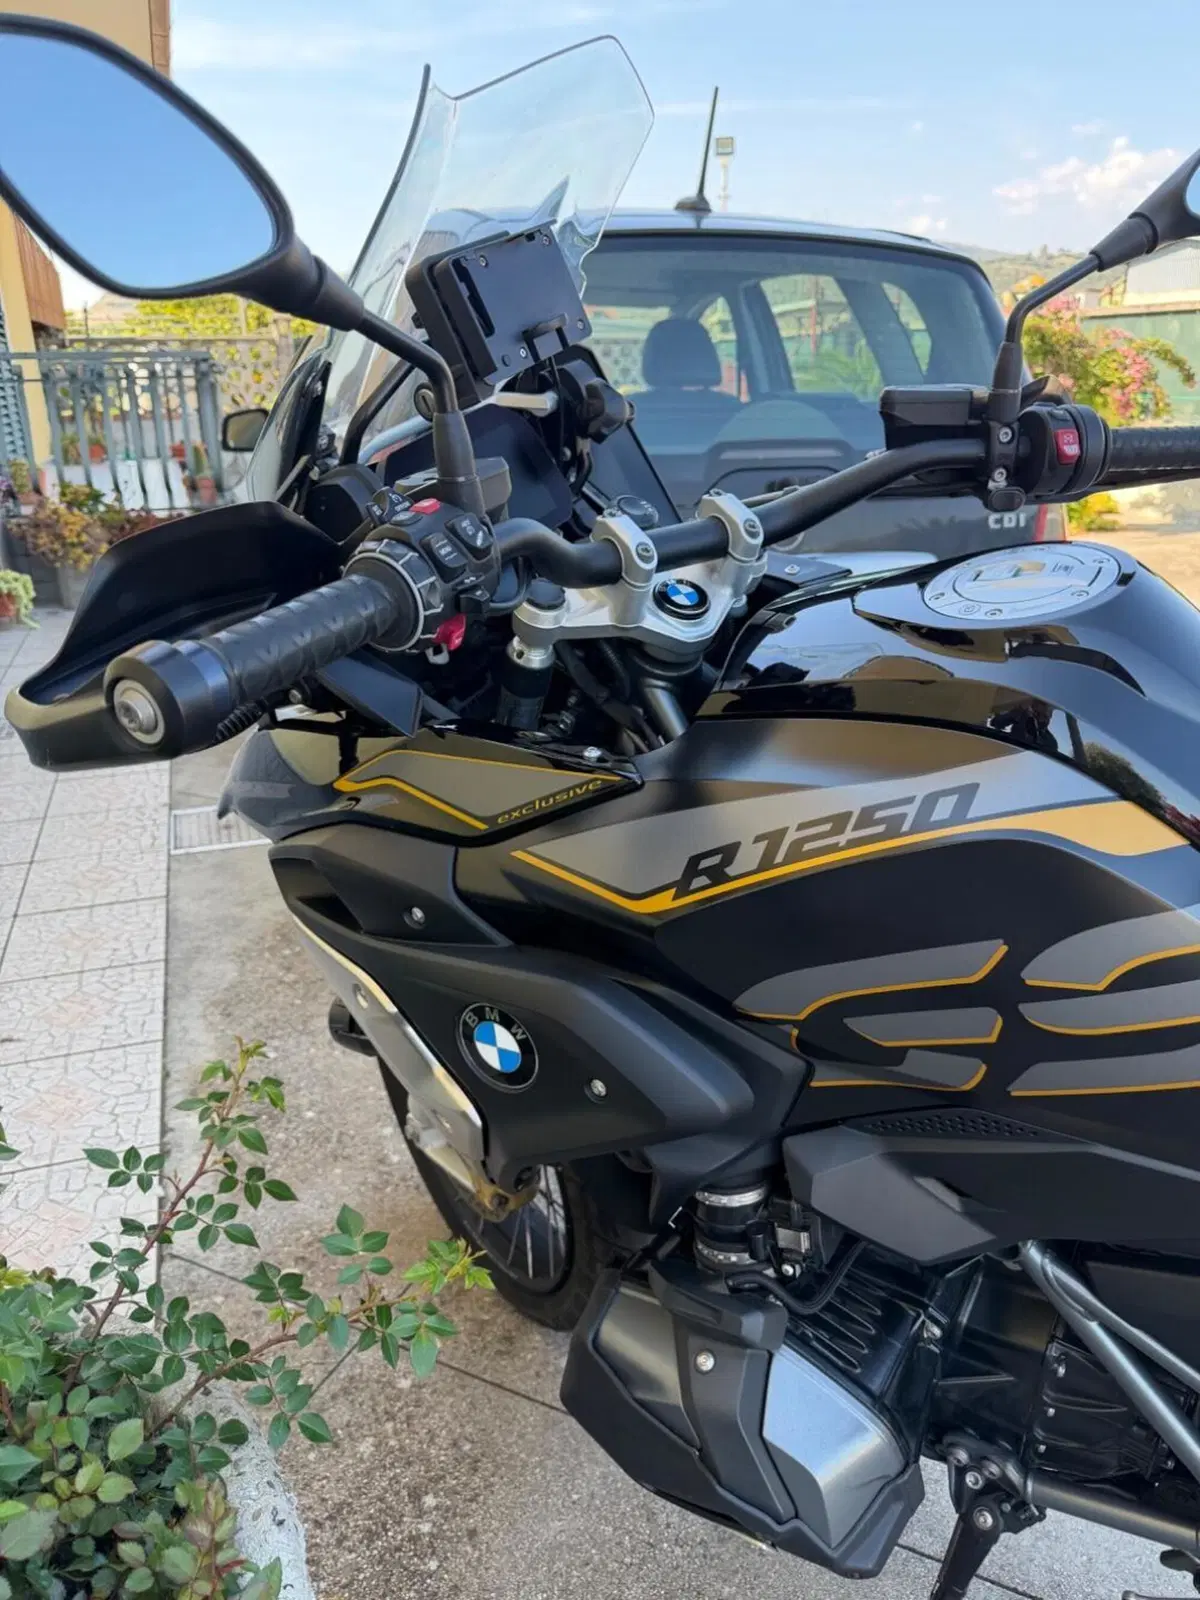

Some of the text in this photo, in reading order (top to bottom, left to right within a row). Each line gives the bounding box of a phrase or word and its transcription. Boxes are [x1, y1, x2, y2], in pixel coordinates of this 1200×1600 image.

[987, 512, 1027, 529] CDI
[497, 780, 602, 824] exclusive
[465, 1007, 528, 1040] BMW
